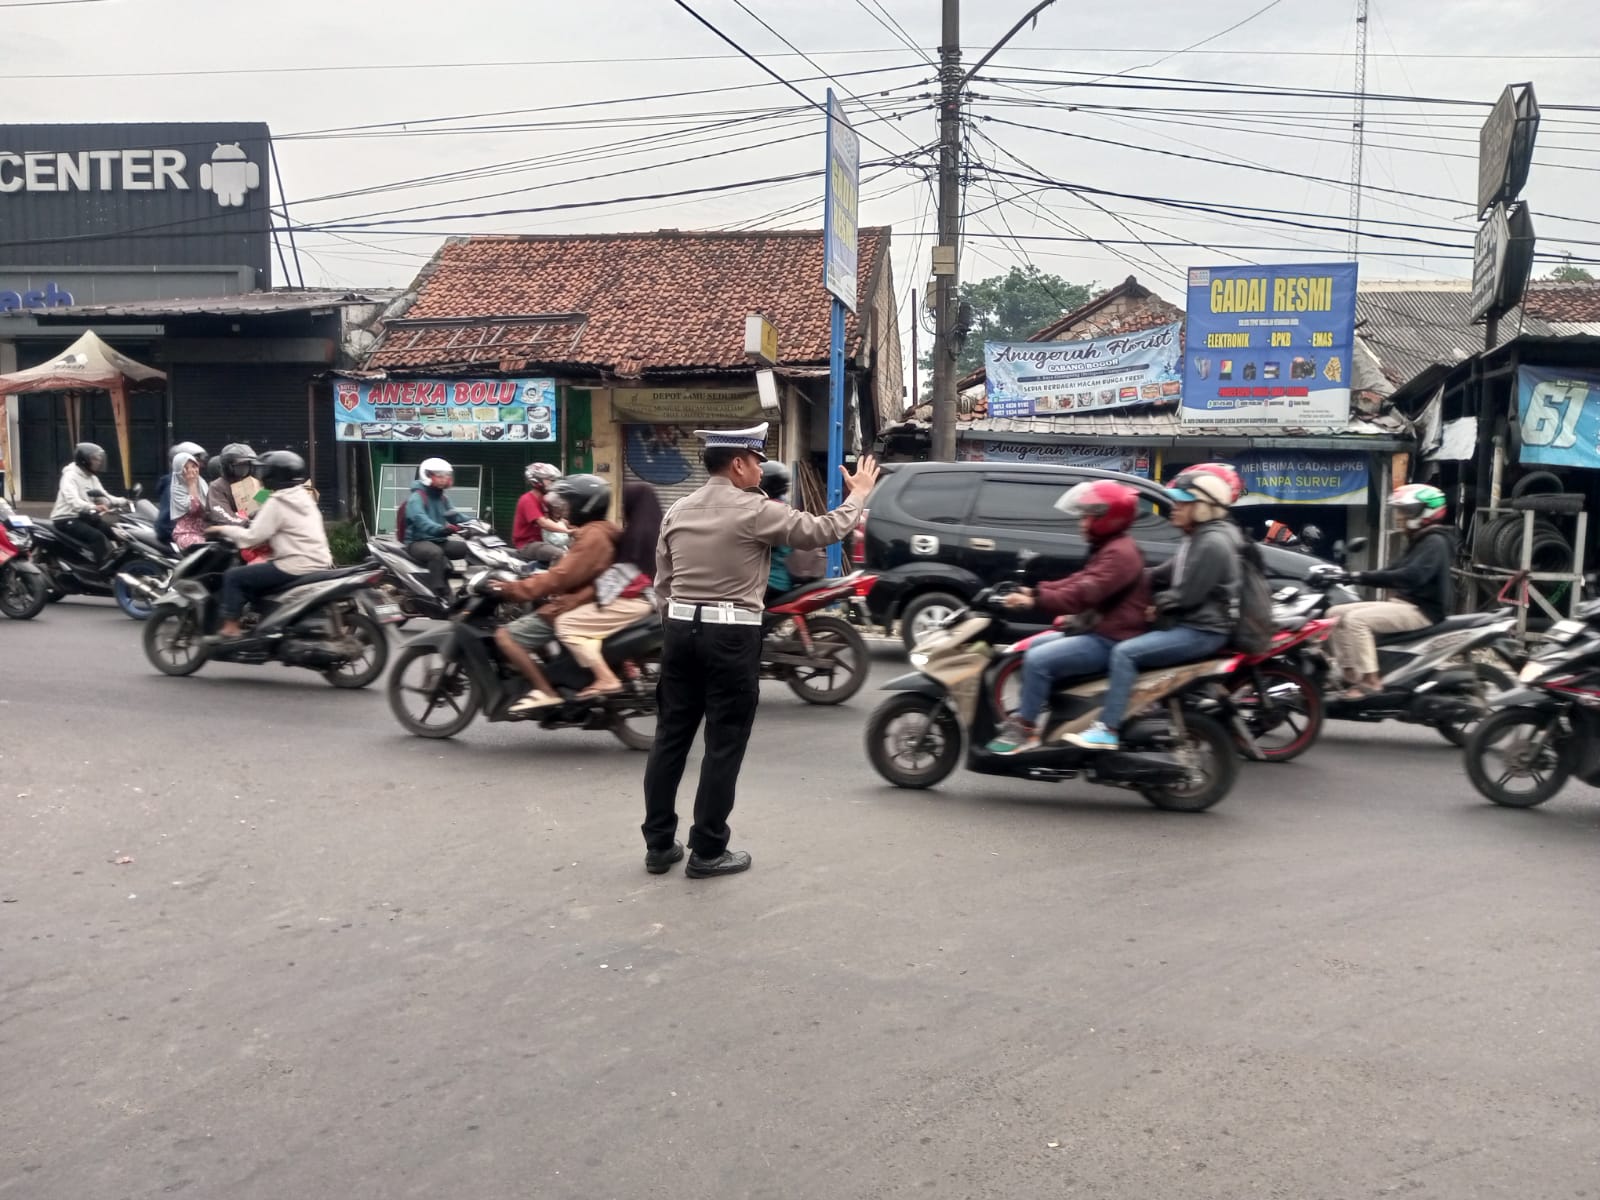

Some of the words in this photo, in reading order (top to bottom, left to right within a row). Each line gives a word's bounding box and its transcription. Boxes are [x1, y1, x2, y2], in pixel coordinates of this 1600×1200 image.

[0, 149, 189, 193] CENTER
[832, 158, 856, 219] GADAI
[1210, 278, 1268, 314] GADAI
[1273, 276, 1333, 312] RESMI
[993, 342, 1100, 368] Anugerah
[1107, 328, 1173, 356] Florist
[1207, 333, 1250, 349] ELEKTRONIK
[1271, 332, 1292, 347] BPKB
[1312, 332, 1333, 346] EMAS
[1048, 363, 1086, 373] CABANG
[1086, 358, 1120, 370] BOGOR
[1023, 385, 1042, 393] SEDIA
[1043, 383, 1076, 391] BERBAGAI
[1077, 380, 1101, 388] MACAM
[1102, 376, 1124, 385] BUNGA
[1125, 374, 1144, 382] FRESH
[368, 382, 447, 405] ANEKA
[453, 382, 517, 404] BOLU
[989, 443, 1065, 460] Anugerah
[1071, 444, 1118, 457] Florist
[1242, 461, 1294, 473] MENERIMA
[1297, 461, 1331, 471] GADAI
[1334, 460, 1364, 471] BPKB
[1256, 476, 1292, 488] TANPA
[1295, 475, 1341, 488] SURVEI
